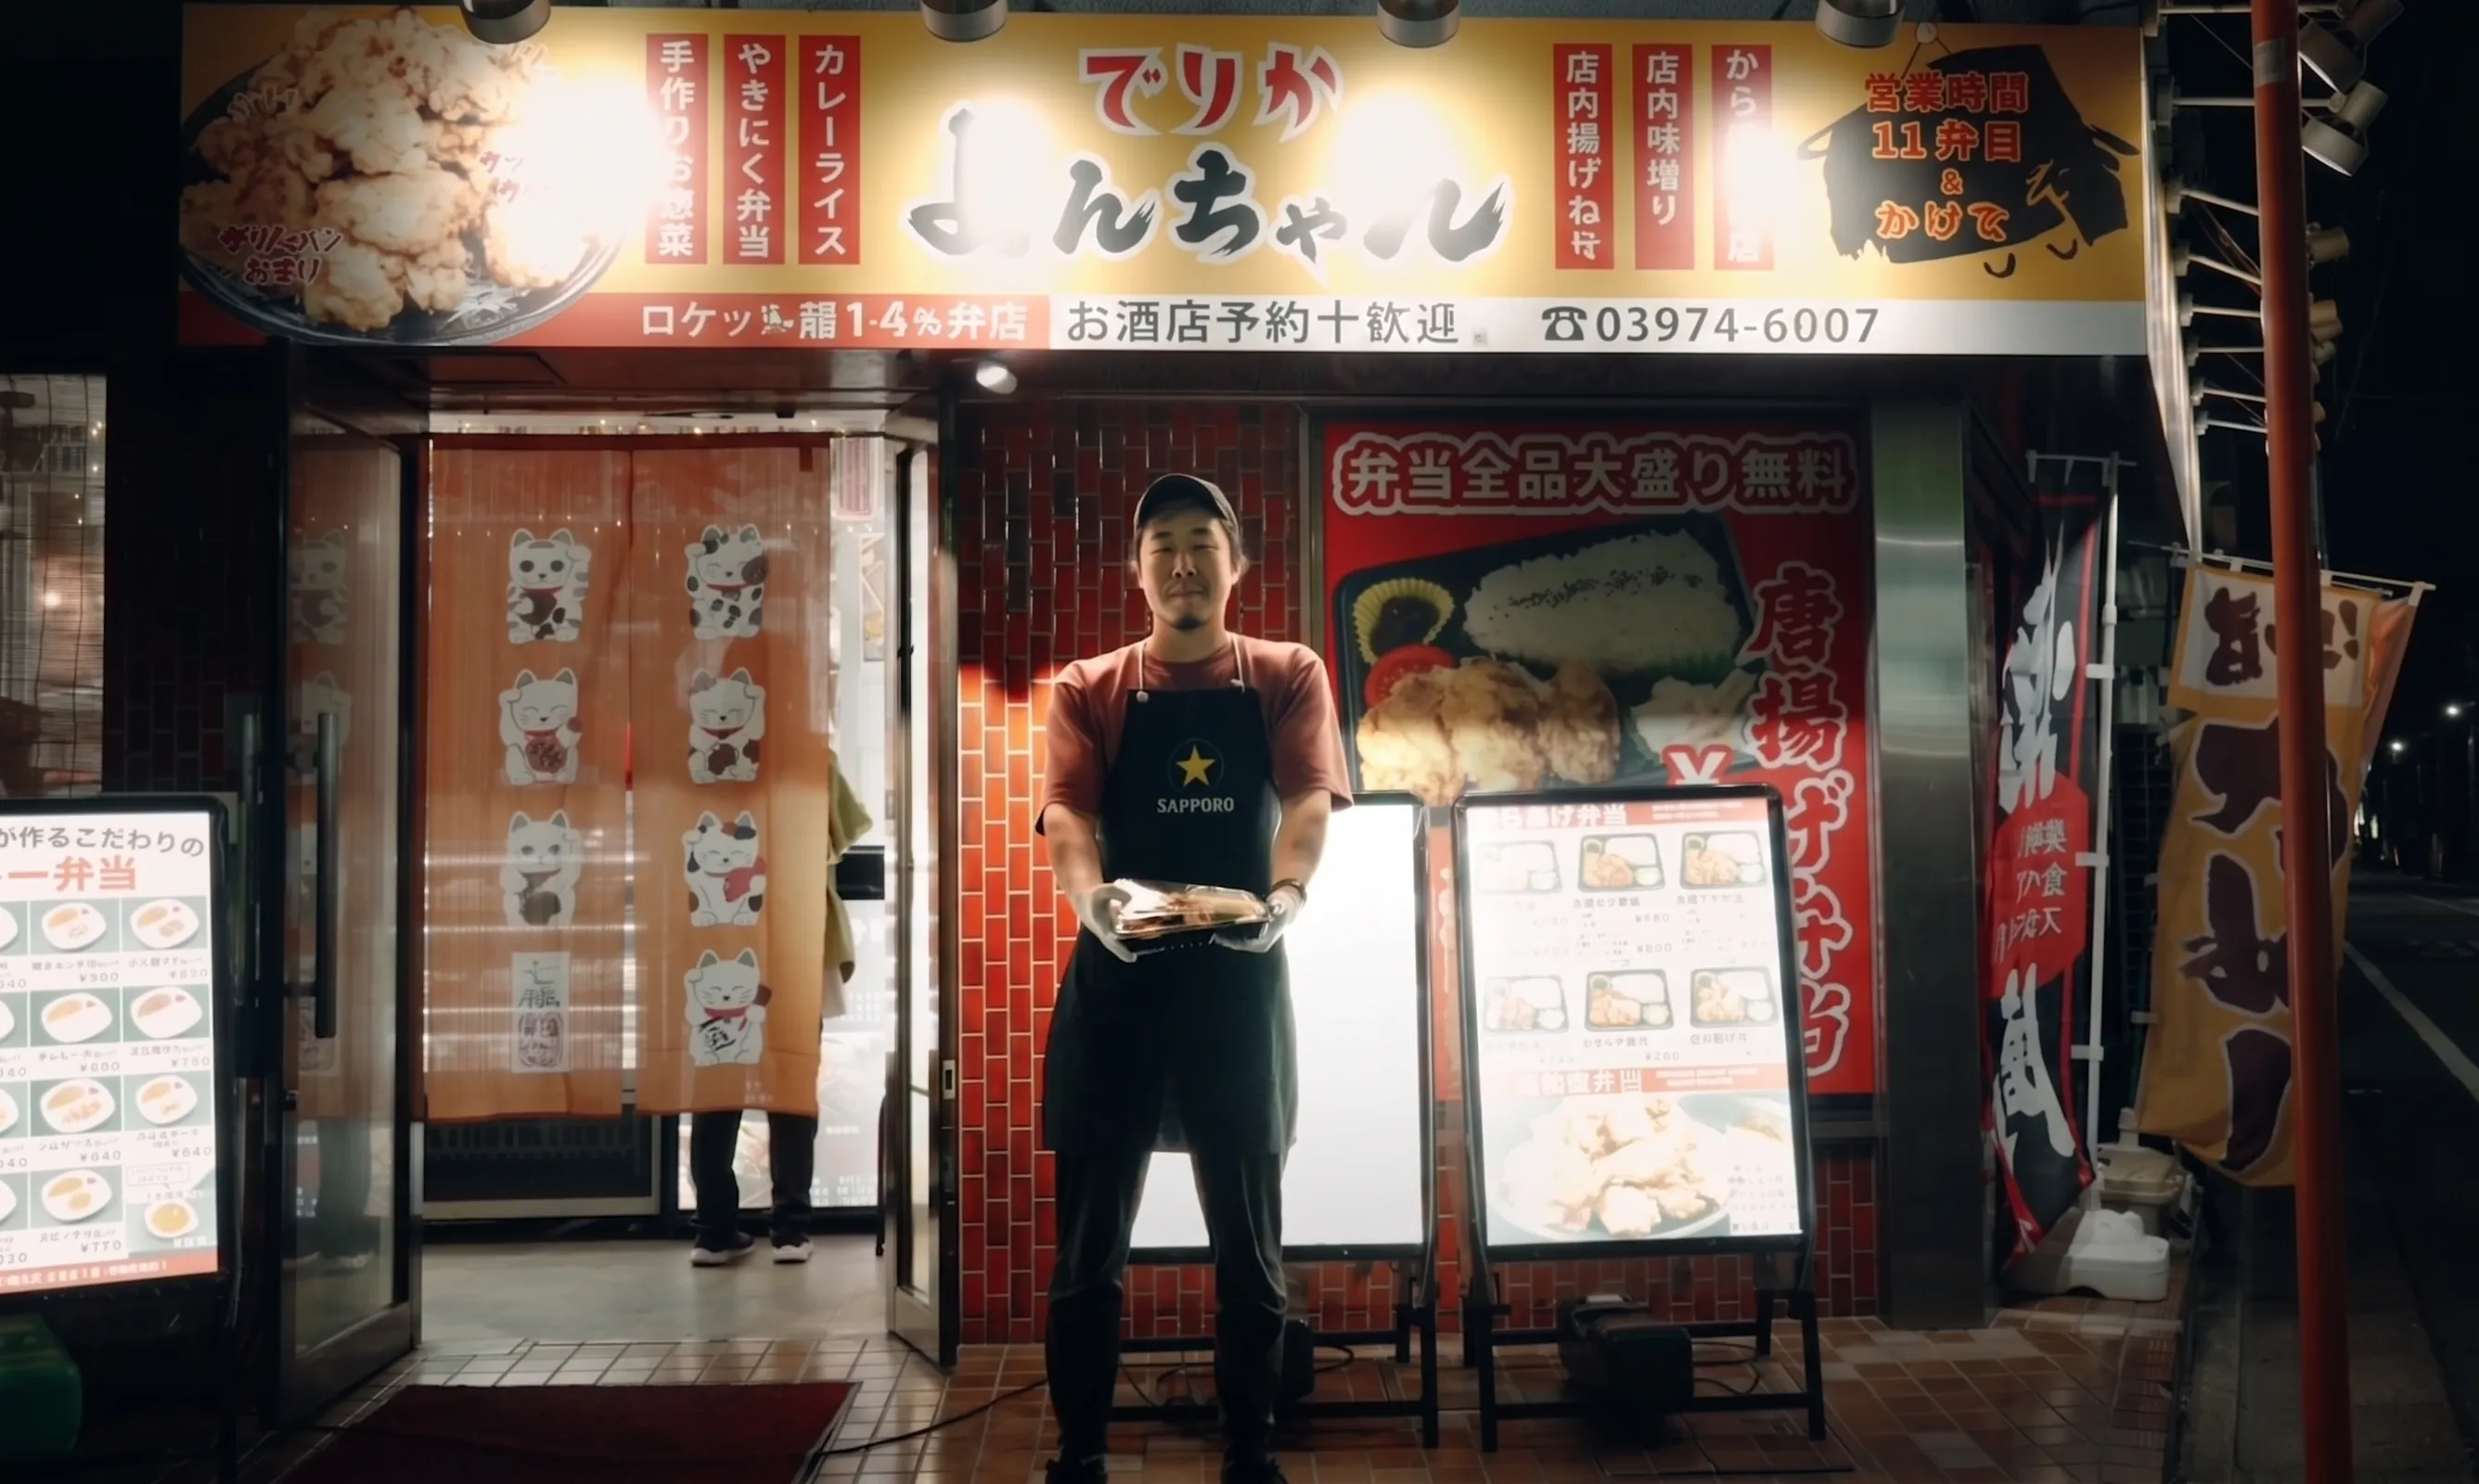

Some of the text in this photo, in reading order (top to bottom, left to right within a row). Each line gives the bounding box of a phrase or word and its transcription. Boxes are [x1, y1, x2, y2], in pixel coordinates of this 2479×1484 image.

[1079, 43, 1343, 142] でりか
[1865, 70, 2029, 113] 営業時間
[737, 43, 772, 258] やきにく弁当
[814, 44, 847, 256] カレーライス
[1940, 167, 1964, 196] &
[1597, 307, 1879, 343] 03974-6007
[1346, 445, 1848, 504] 弁当全品大盛り無料
[1157, 797, 1235, 813] SAPPORO
[0, 854, 135, 892] ー弁当
